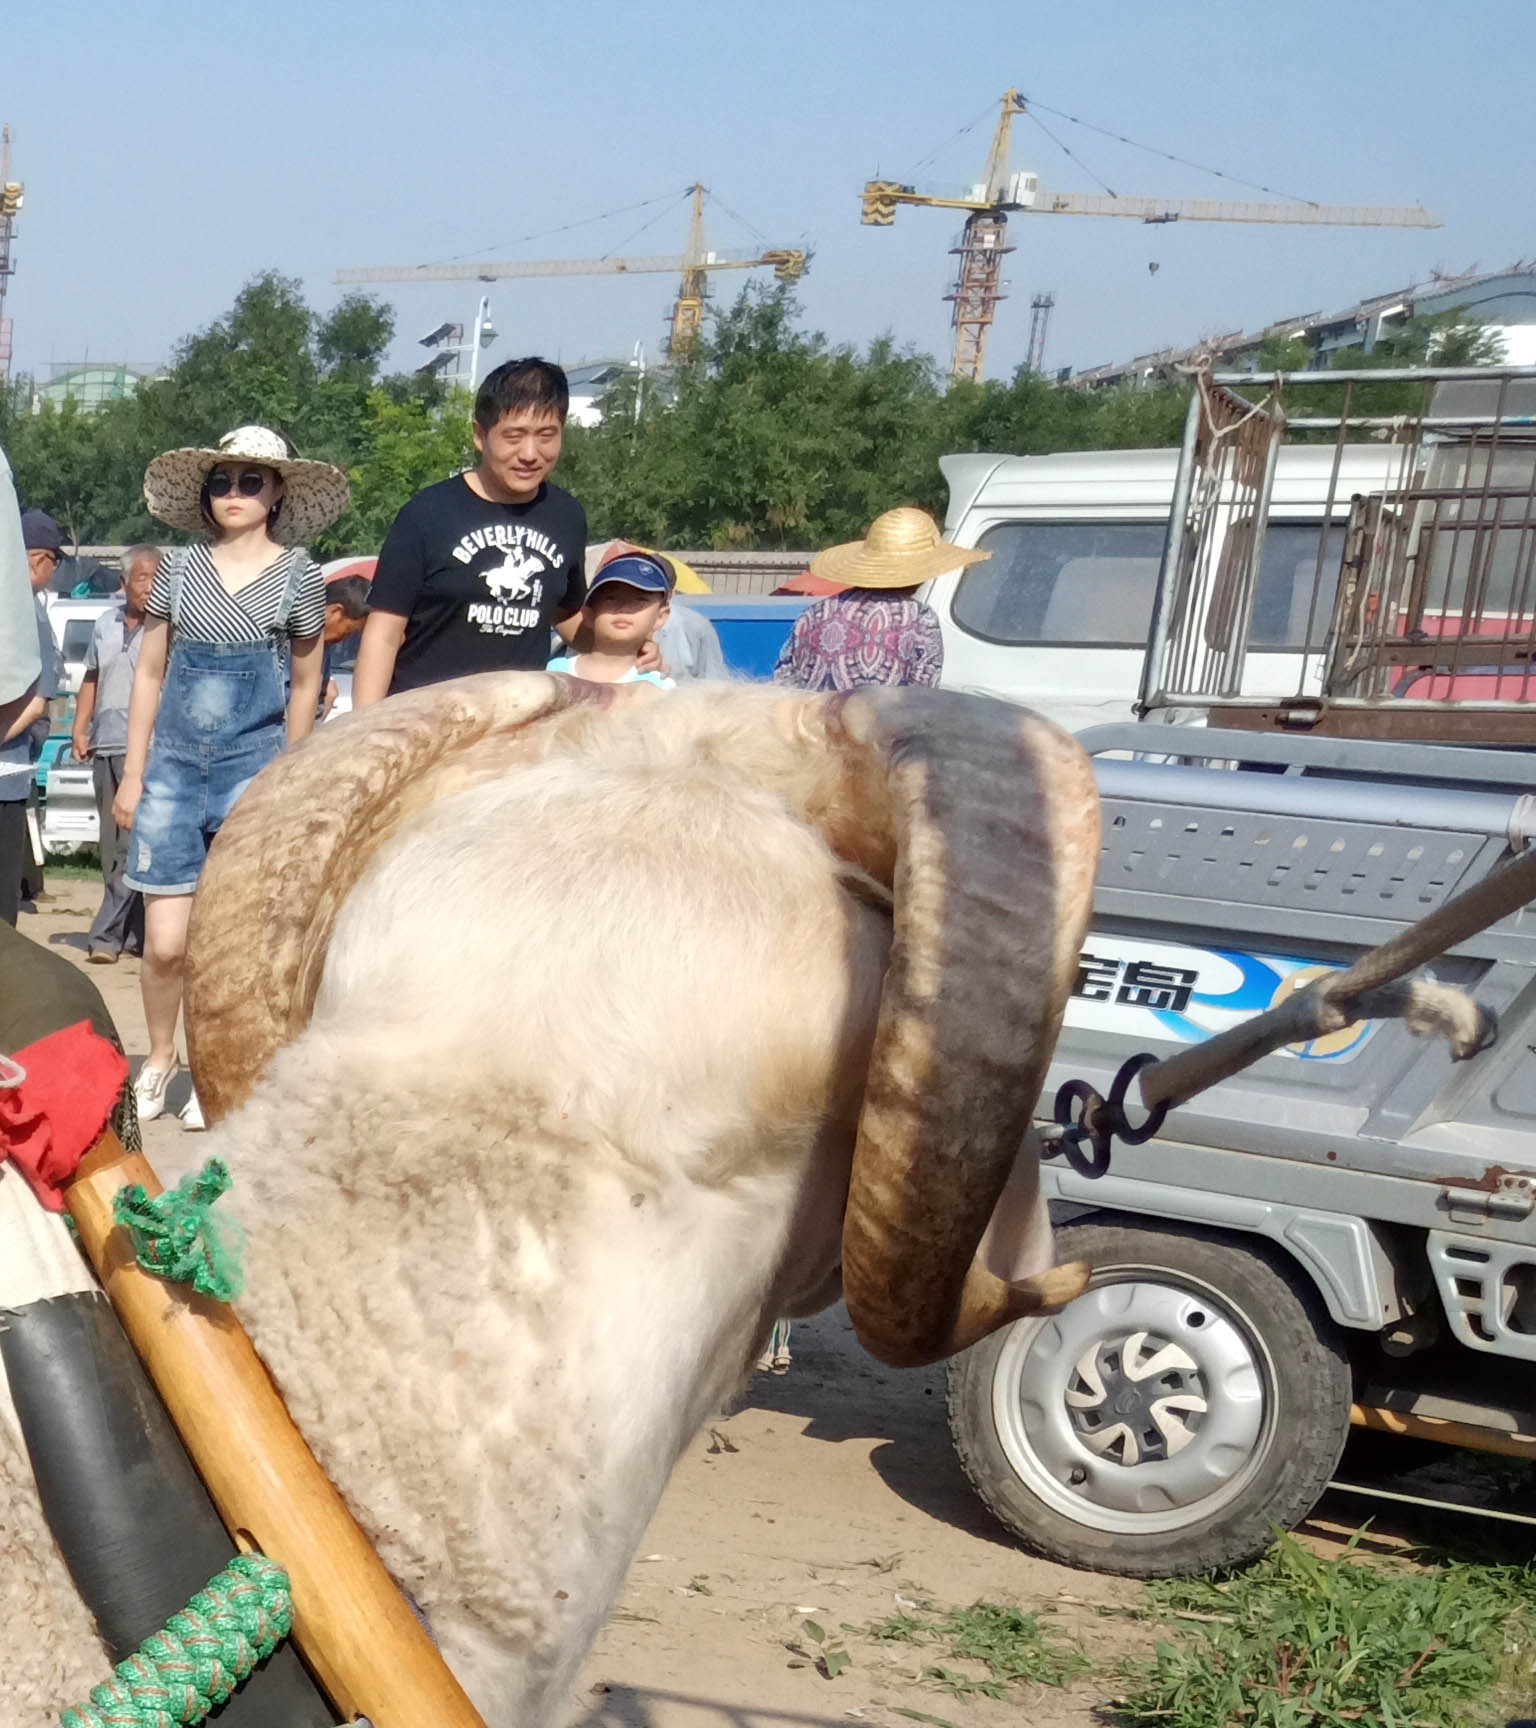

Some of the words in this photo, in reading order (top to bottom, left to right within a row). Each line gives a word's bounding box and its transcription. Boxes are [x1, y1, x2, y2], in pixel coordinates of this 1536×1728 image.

[452, 525, 526, 564] BEVERLY
[525, 528, 564, 568] HILLS
[468, 604, 503, 624] POLO
[504, 607, 540, 628] CLUB
